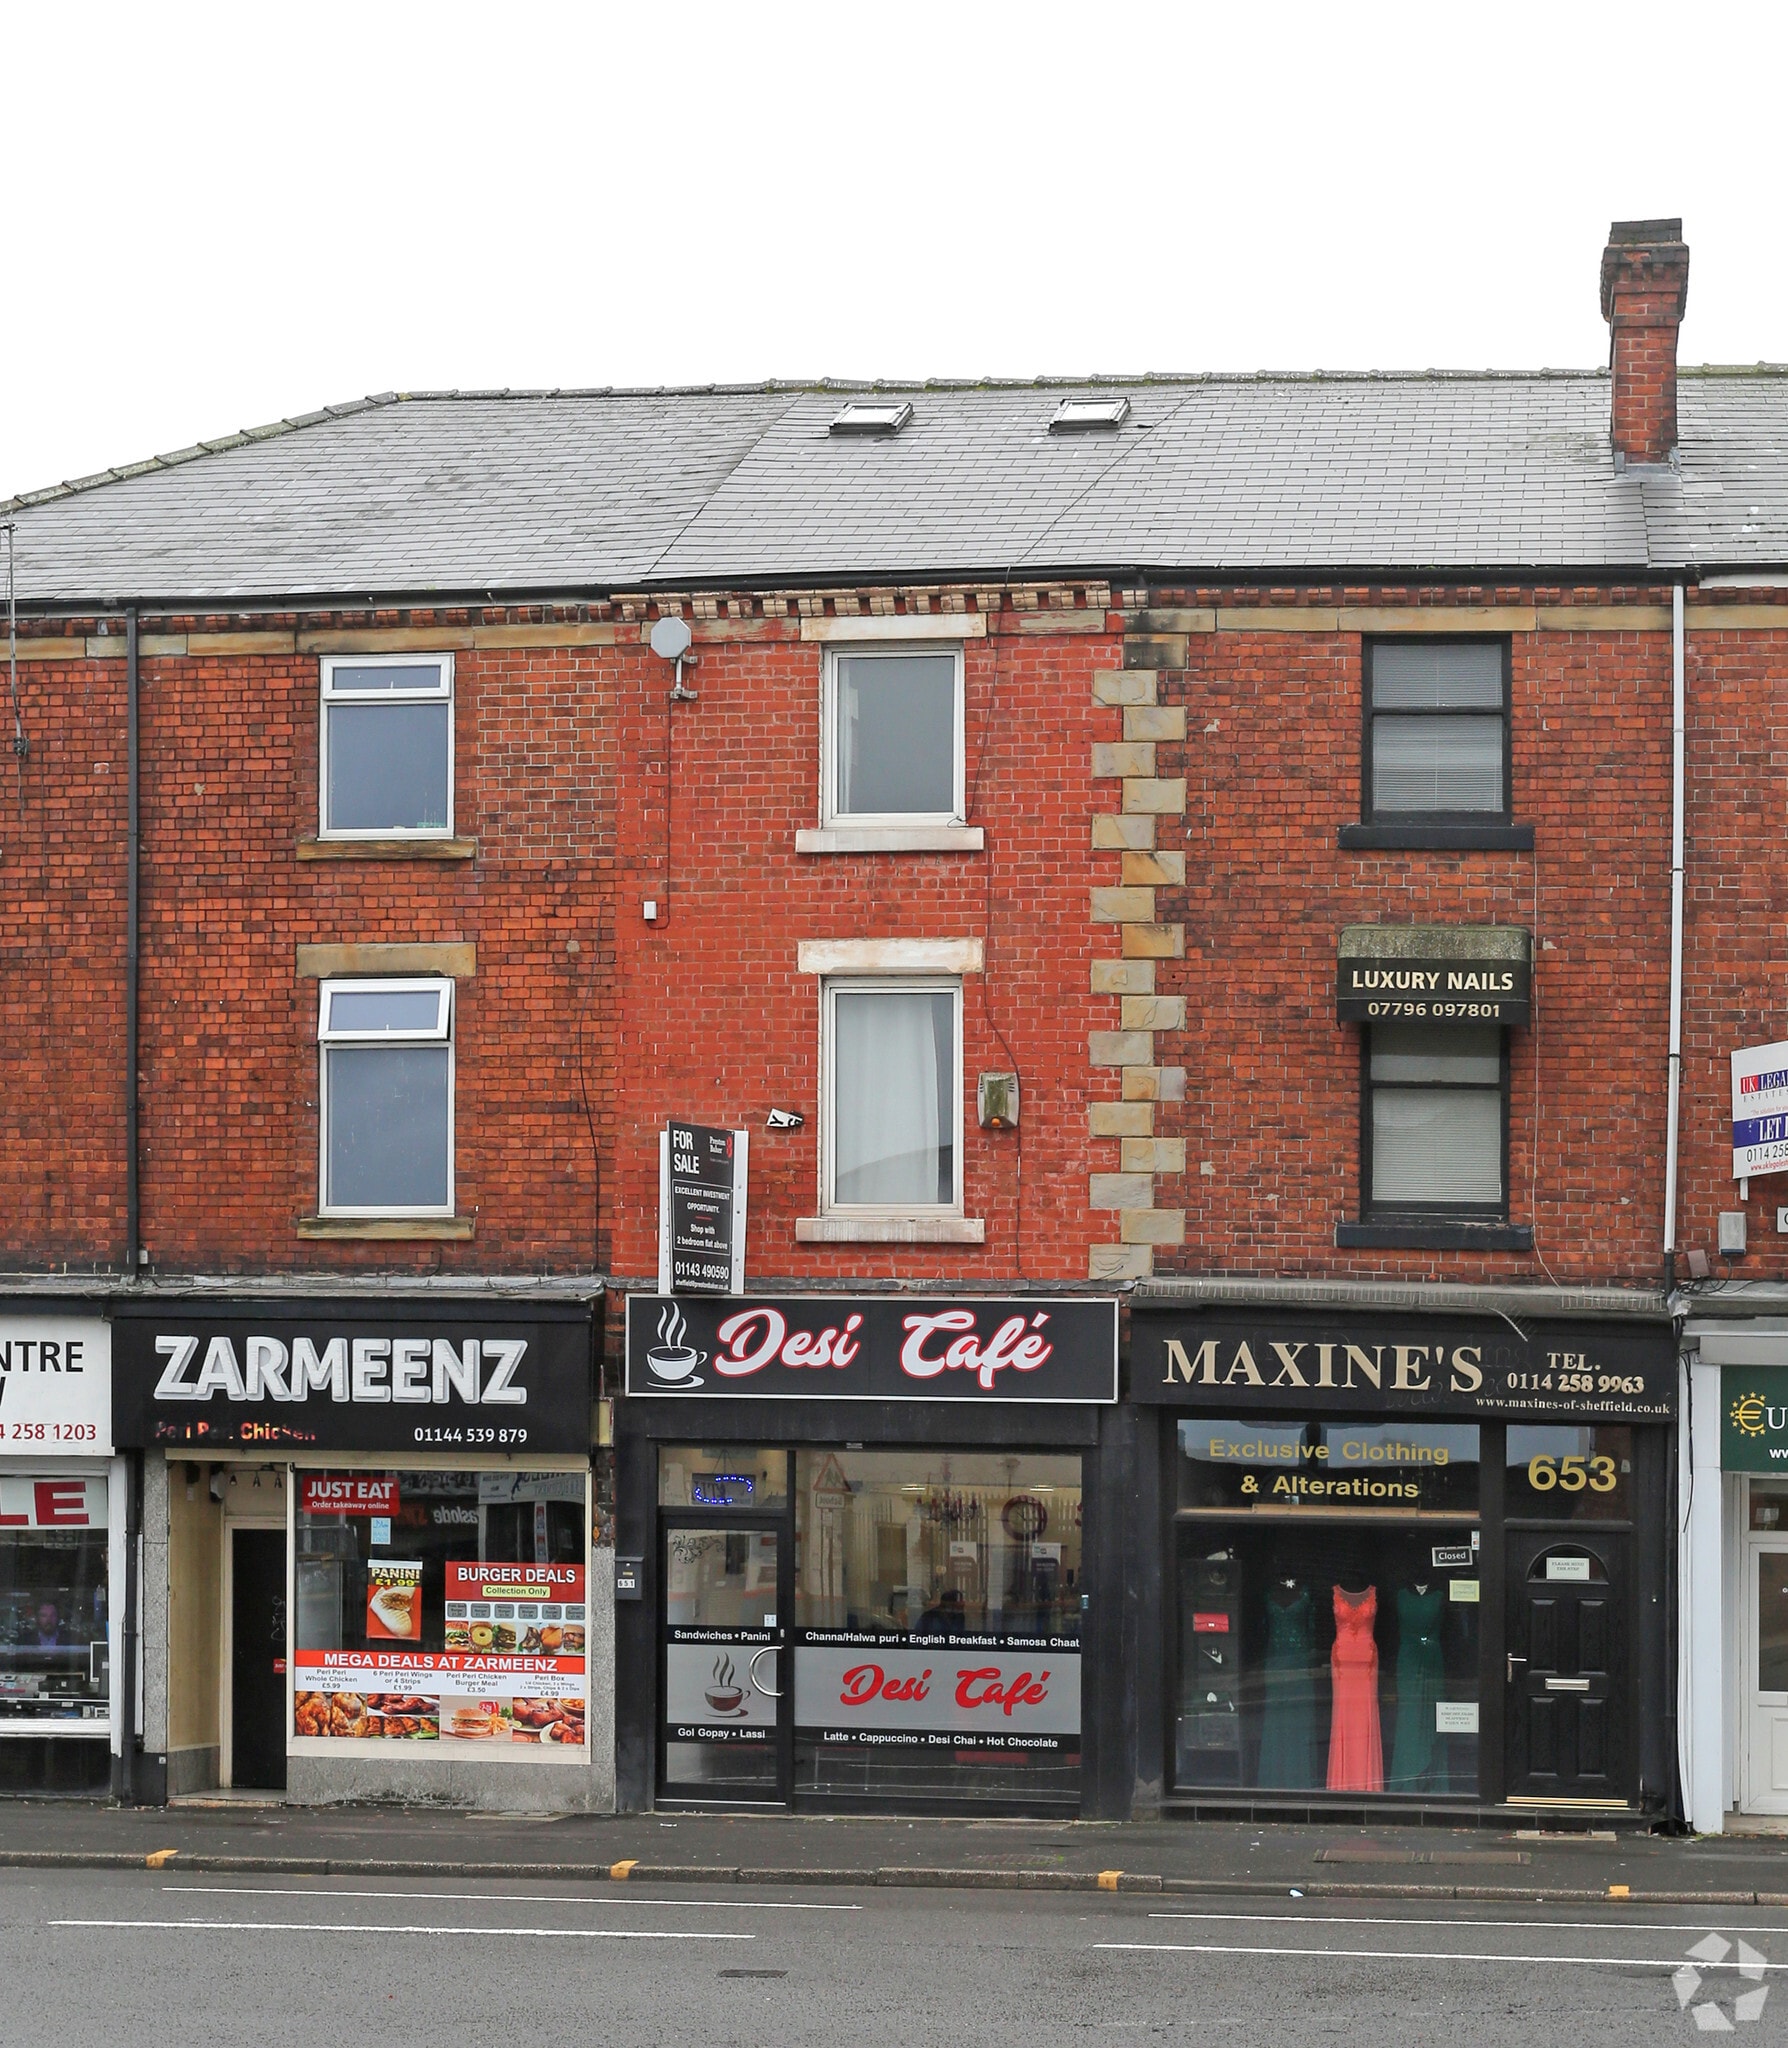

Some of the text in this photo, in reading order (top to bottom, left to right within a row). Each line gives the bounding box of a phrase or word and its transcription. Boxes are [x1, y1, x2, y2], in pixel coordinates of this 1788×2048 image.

[1352, 970, 1514, 991] LUXURY NAILS
[1367, 1002, 1500, 1018] 07796 097801
[1742, 1070, 1788, 1093] UK LEGA
[1759, 1117, 1782, 1142] LET
[673, 1130, 693, 1151] FOR
[1747, 1147, 1770, 1162] 0114
[674, 1155, 700, 1175] SALE
[675, 1186, 730, 1201] EXCELLENT INVESTMENT
[690, 1224, 715, 1235] Shop with
[677, 1235, 728, 1250] 2 bedroom flat above
[675, 1261, 729, 1280] 01143 490590
[713, 1306, 1053, 1390] Desi Café
[154, 1335, 528, 1405] ZARMEENZ
[1162, 1339, 1483, 1393] MAXINE'S
[1547, 1351, 1601, 1372] TEL.
[1507, 1371, 1646, 1395] 0114 258 9963
[1475, 1395, 1671, 1415] www.maxines-of-sheffield.co.uk
[12, 1423, 45, 1440] 258
[53, 1424, 97, 1441] 1203
[413, 1427, 528, 1444] 01144 539 879
[1210, 1439, 1450, 1467] Exclusive Clothing
[1527, 1454, 1618, 1493] 653
[307, 1481, 394, 1499] JUST EAT
[1241, 1475, 1419, 1499] & Alterations
[311, 1500, 390, 1511] Order takeaway online
[1438, 1551, 1466, 1561] Closed
[371, 1567, 420, 1580] PANINI
[375, 1578, 415, 1587] £1.99
[457, 1567, 576, 1584] BURGER DEALS
[486, 1587, 548, 1597] Collection Only
[674, 1630, 771, 1641] Sandwiches Panini
[805, 1631, 1080, 1649] Channa/Halwa puri English Breakfast Samosa Chaat
[324, 1653, 558, 1672] MEGA DEALS AT ZARMEENZ
[329, 1675, 358, 1683] Chicken
[839, 1663, 1052, 1717] Desi Café
[677, 1727, 766, 1740] Gol Gopay Lassi
[823, 1731, 1058, 1748] Latte Cappuccino Desi Chai Hot Chocolate
